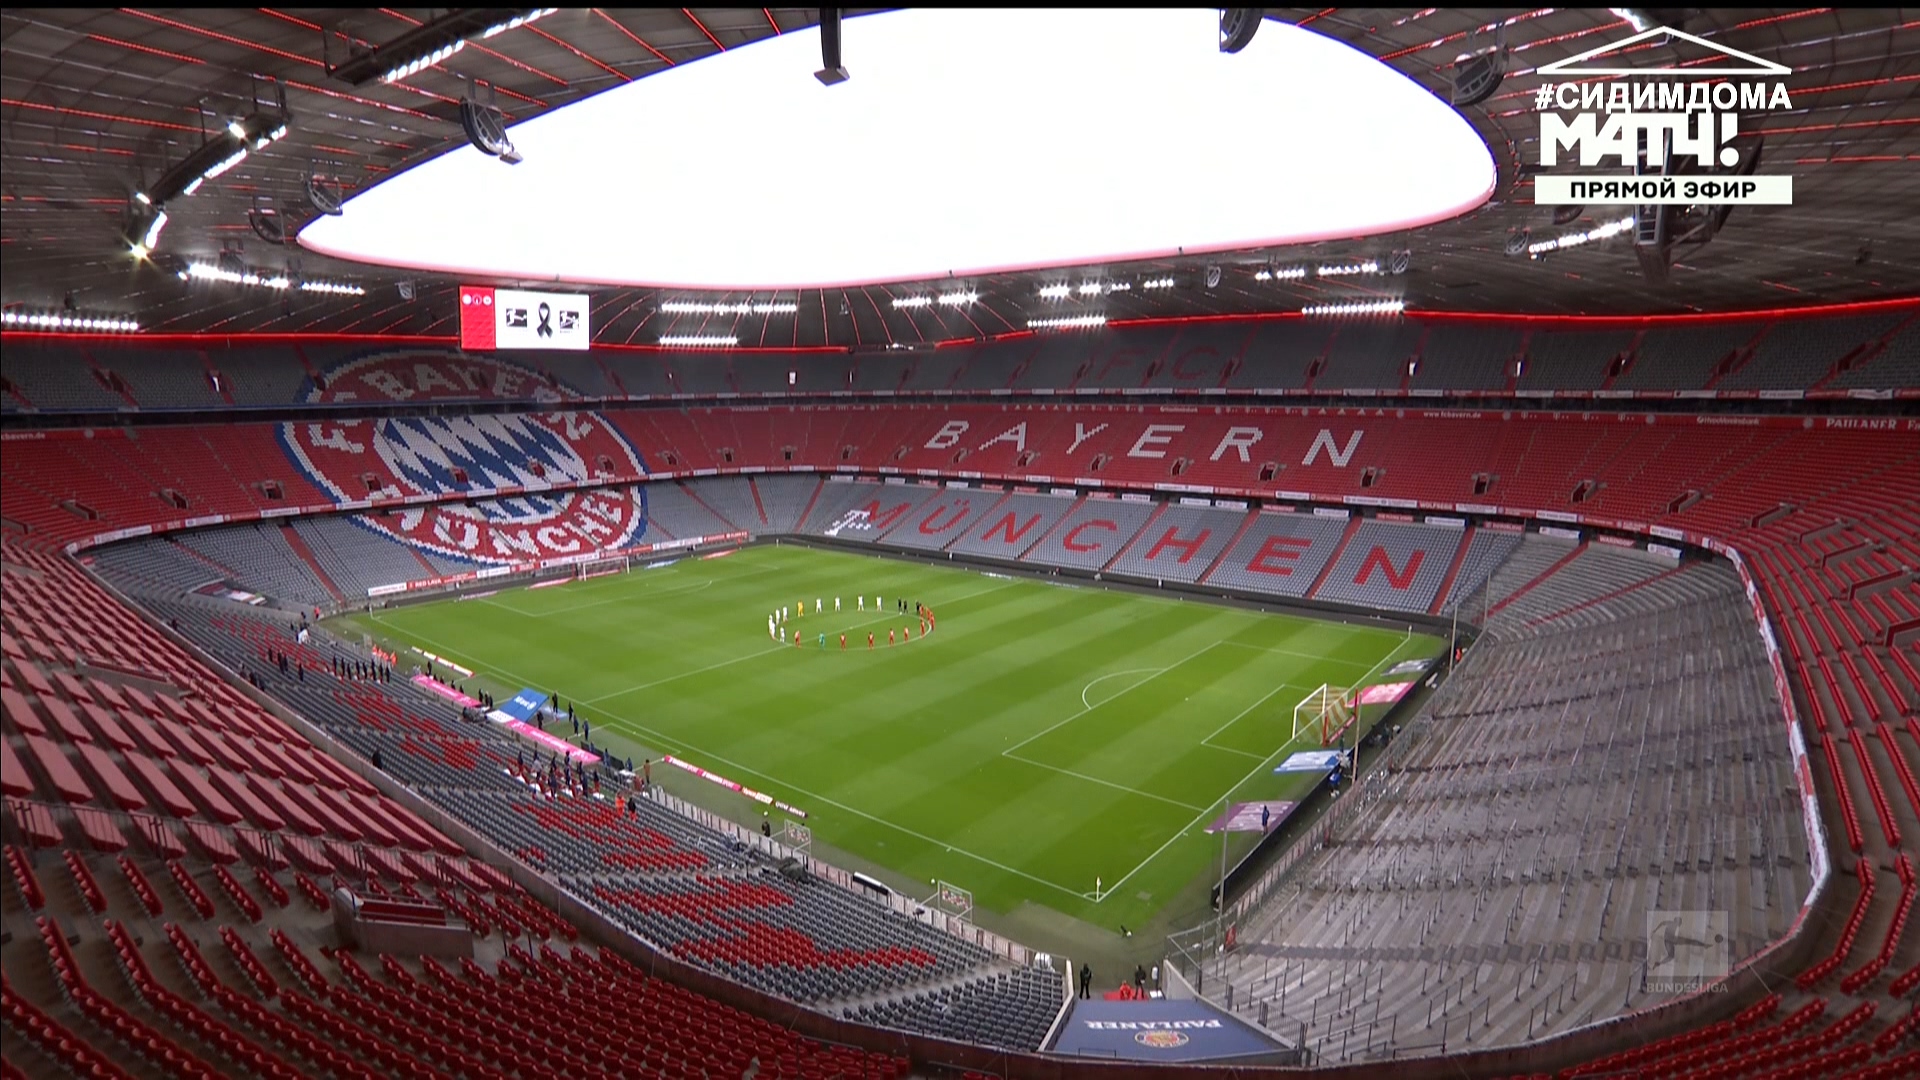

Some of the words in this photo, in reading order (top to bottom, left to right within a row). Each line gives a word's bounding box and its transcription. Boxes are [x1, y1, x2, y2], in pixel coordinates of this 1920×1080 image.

[1826, 418, 1897, 429] PAULANER
[924, 420, 1364, 467] BAYERN
[862, 498, 1425, 589] MÜNCHEN
[1085, 1019, 1222, 1030] PAULANER
